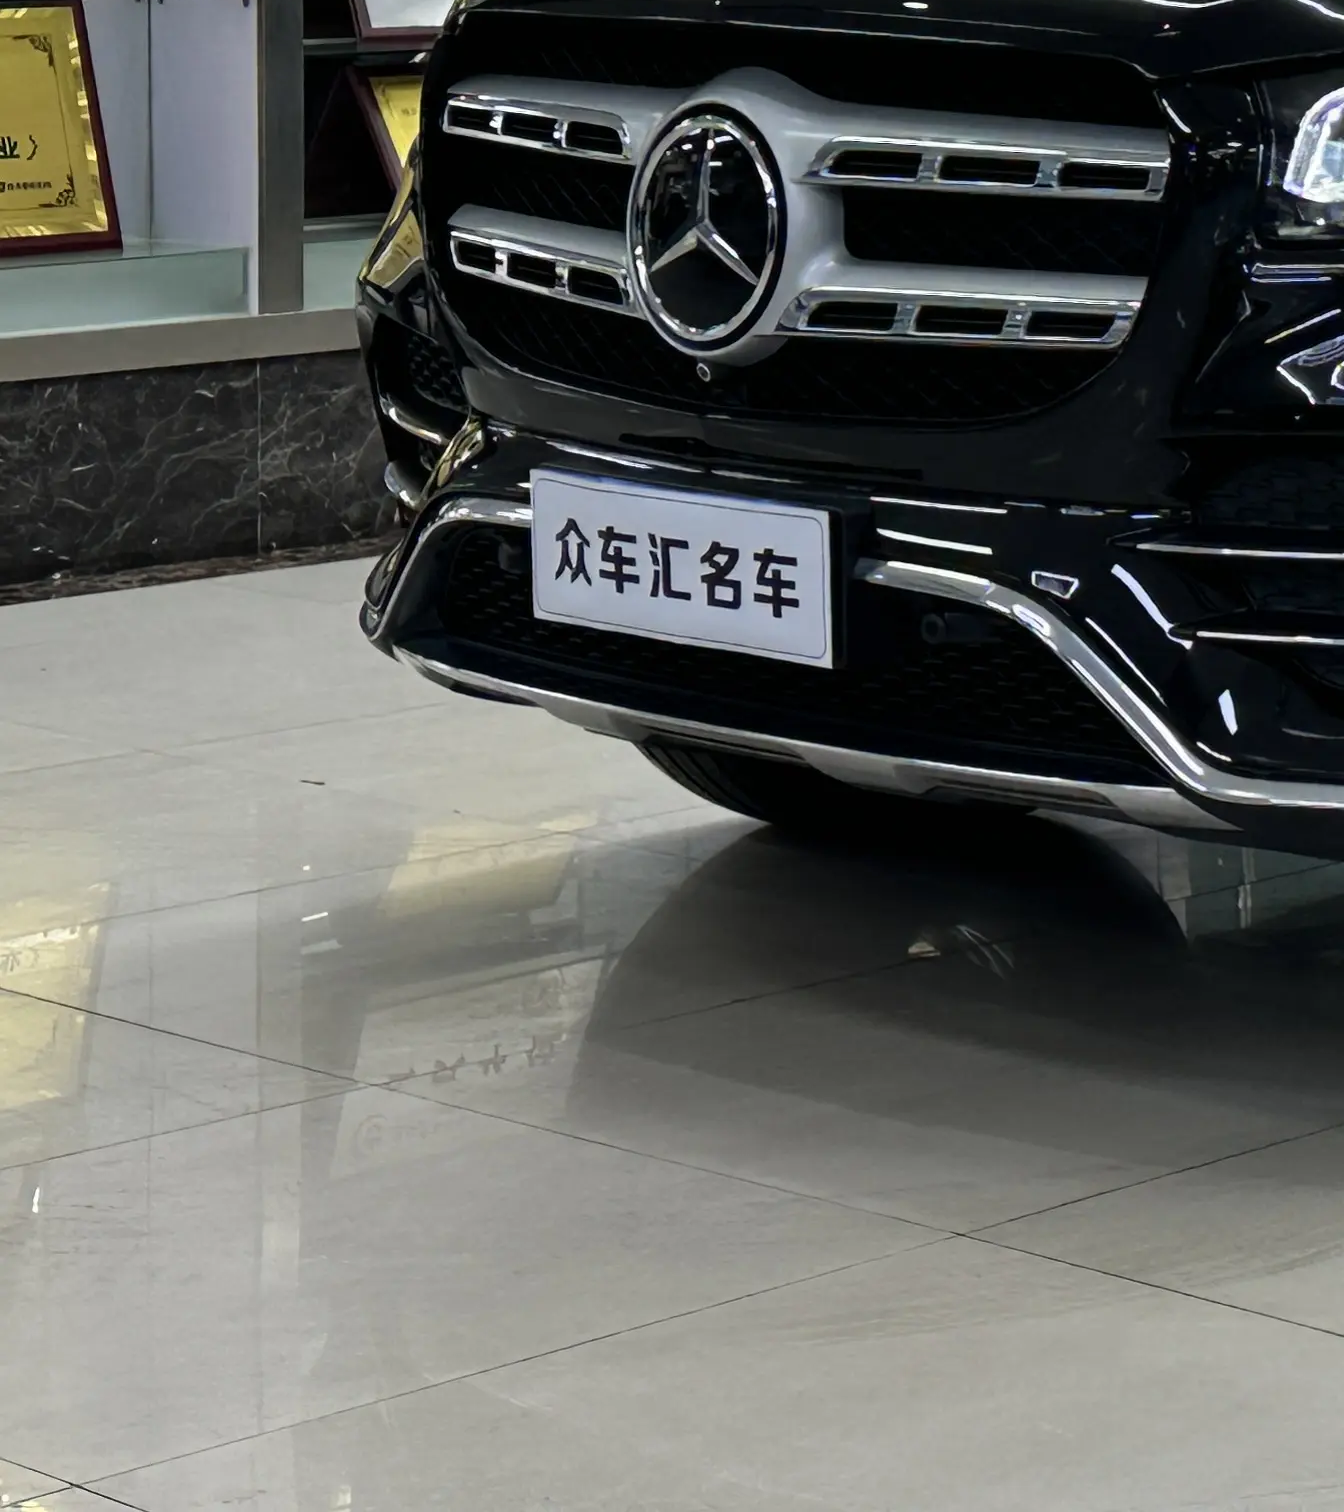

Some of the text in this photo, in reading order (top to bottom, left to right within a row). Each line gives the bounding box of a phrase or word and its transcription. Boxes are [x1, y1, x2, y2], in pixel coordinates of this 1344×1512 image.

[554, 517, 800, 619] 众车汇名车
